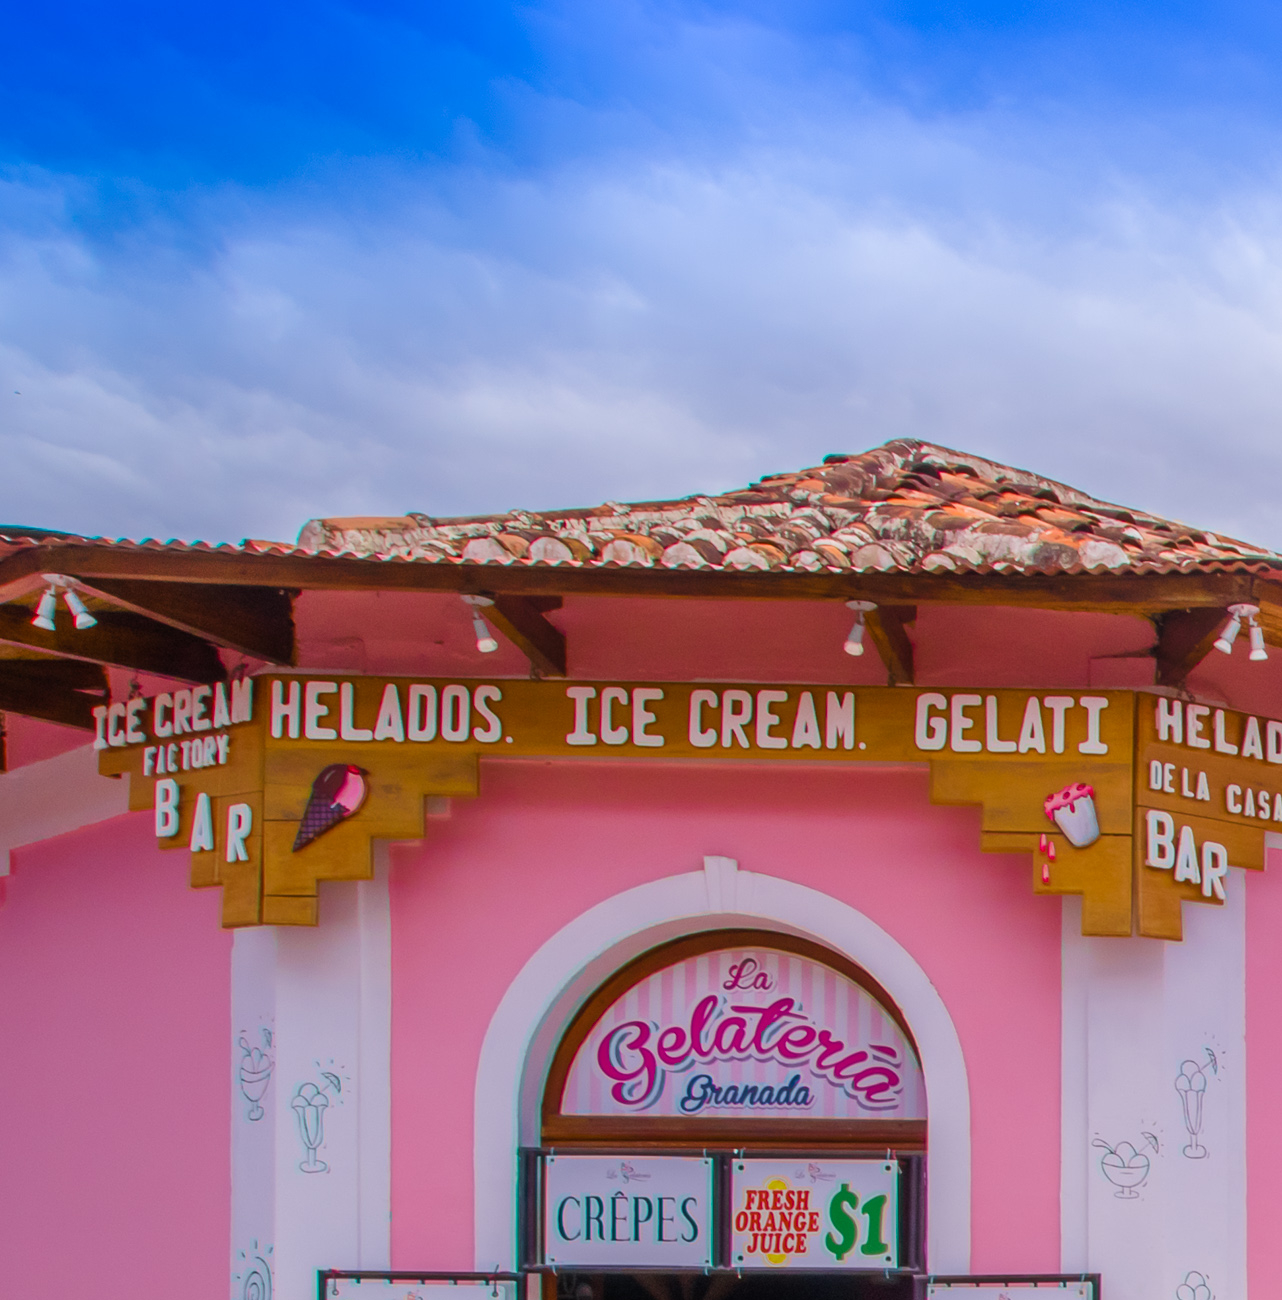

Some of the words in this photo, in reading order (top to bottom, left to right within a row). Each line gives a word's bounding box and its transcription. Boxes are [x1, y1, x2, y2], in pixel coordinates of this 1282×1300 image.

[92, 698, 147, 750] ICE
[153, 676, 253, 738] CREAM
[565, 685, 665, 747] ICE
[914, 692, 1109, 756] GELATI
[143, 734, 231, 776] FACTORY
[1148, 759, 1175, 793] DE
[1180, 766, 1210, 802] LA
[154, 778, 253, 863] BAR
[1145, 808, 1228, 900] BAR
[723, 957, 773, 991] La
[680, 1074, 815, 1113] Granada
[557, 1190, 699, 1243] CRÊPES
[734, 1210, 820, 1233] ORANGE
[744, 1189, 811, 1211] FRESH
[824, 1183, 890, 1261] $1
[746, 1232, 807, 1254] JUICE
